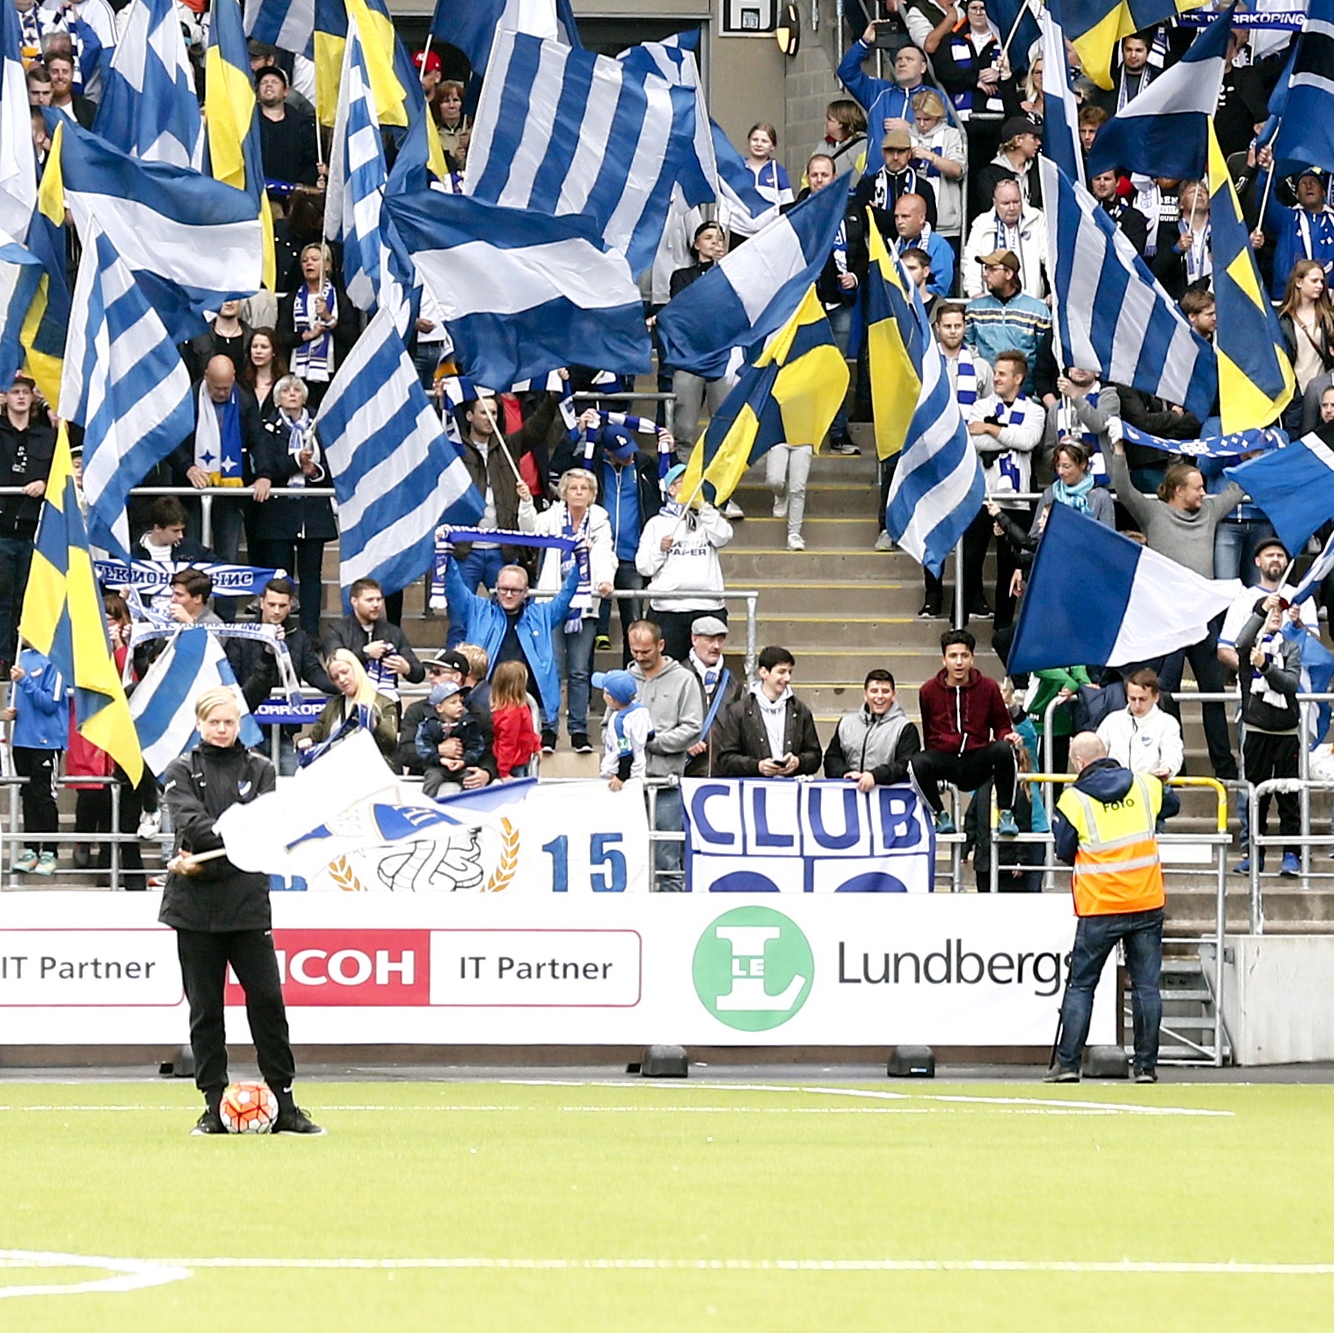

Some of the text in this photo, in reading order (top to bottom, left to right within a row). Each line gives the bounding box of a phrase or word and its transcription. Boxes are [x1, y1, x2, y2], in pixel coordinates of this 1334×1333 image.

[1207, 11, 1306, 25] NRRKÖPING
[667, 546, 708, 557] PAPER
[691, 782, 923, 851] CLUB
[1102, 795, 1136, 814] FOTO
[542, 831, 629, 892] 15
[1, 955, 156, 980] IT Partner
[229, 949, 415, 986] ICOH
[459, 955, 613, 980] IT Partner
[732, 958, 765, 976] LE
